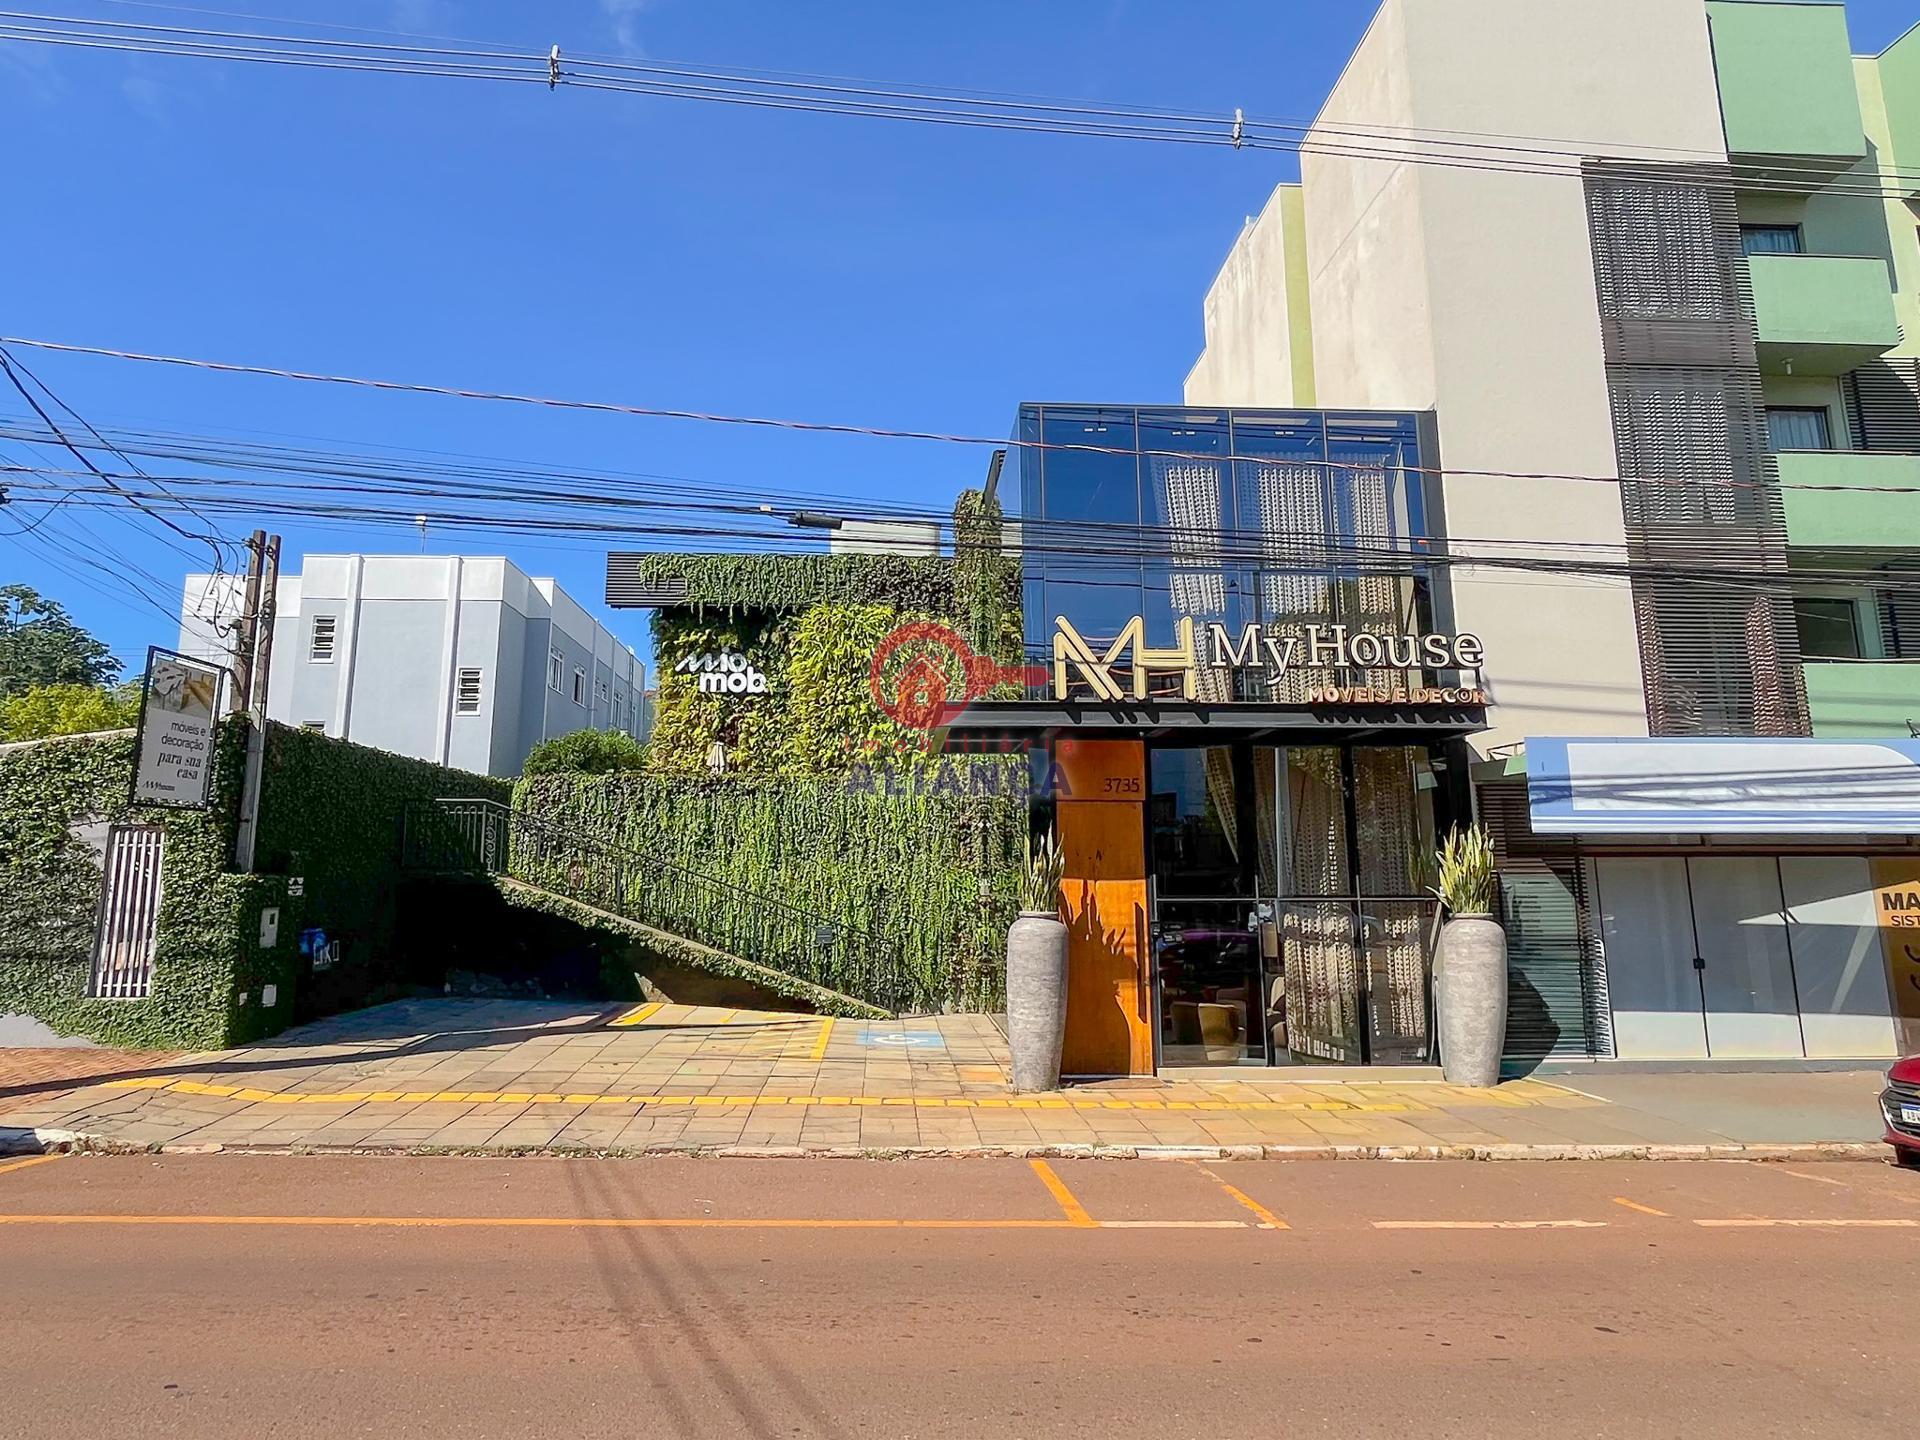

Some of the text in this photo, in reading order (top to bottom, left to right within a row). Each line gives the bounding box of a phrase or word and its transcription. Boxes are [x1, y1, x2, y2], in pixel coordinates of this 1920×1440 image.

[674, 646, 747, 671] mio
[1391, 687, 1408, 703] E
[1411, 686, 1486, 703] DECOR
[171, 720, 206, 737] móveis e
[161, 732, 205, 752] decoração
[157, 752, 202, 768] para sua
[176, 768, 199, 780] casa
[1104, 777, 1140, 793] 3735
